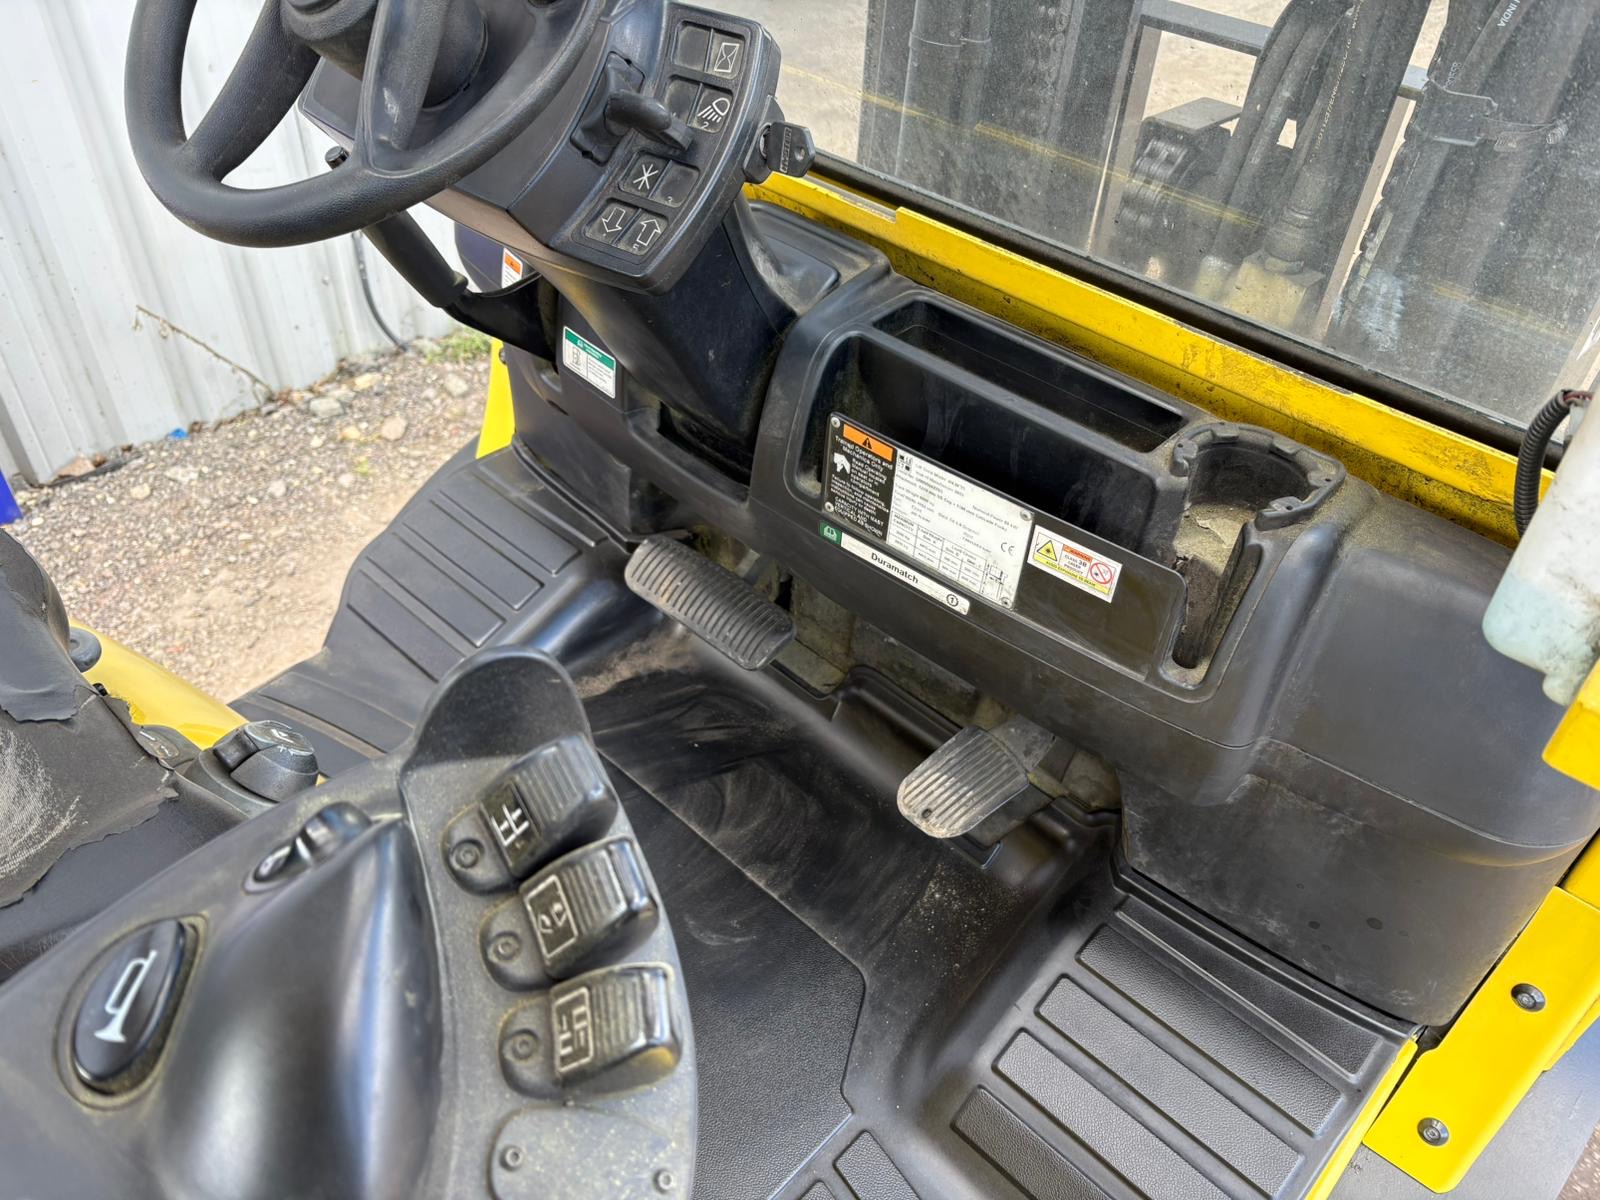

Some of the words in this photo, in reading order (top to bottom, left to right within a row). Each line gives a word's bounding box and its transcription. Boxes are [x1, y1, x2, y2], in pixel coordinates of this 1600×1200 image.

[1497, 3, 1518, 27] INDIA
[842, 445, 870, 464] Mechanics
[870, 460, 883, 472] Only
[854, 445, 880, 464] Operators
[882, 460, 892, 470] and
[864, 464, 887, 481] Operating
[871, 552, 920, 584] Duramatch
